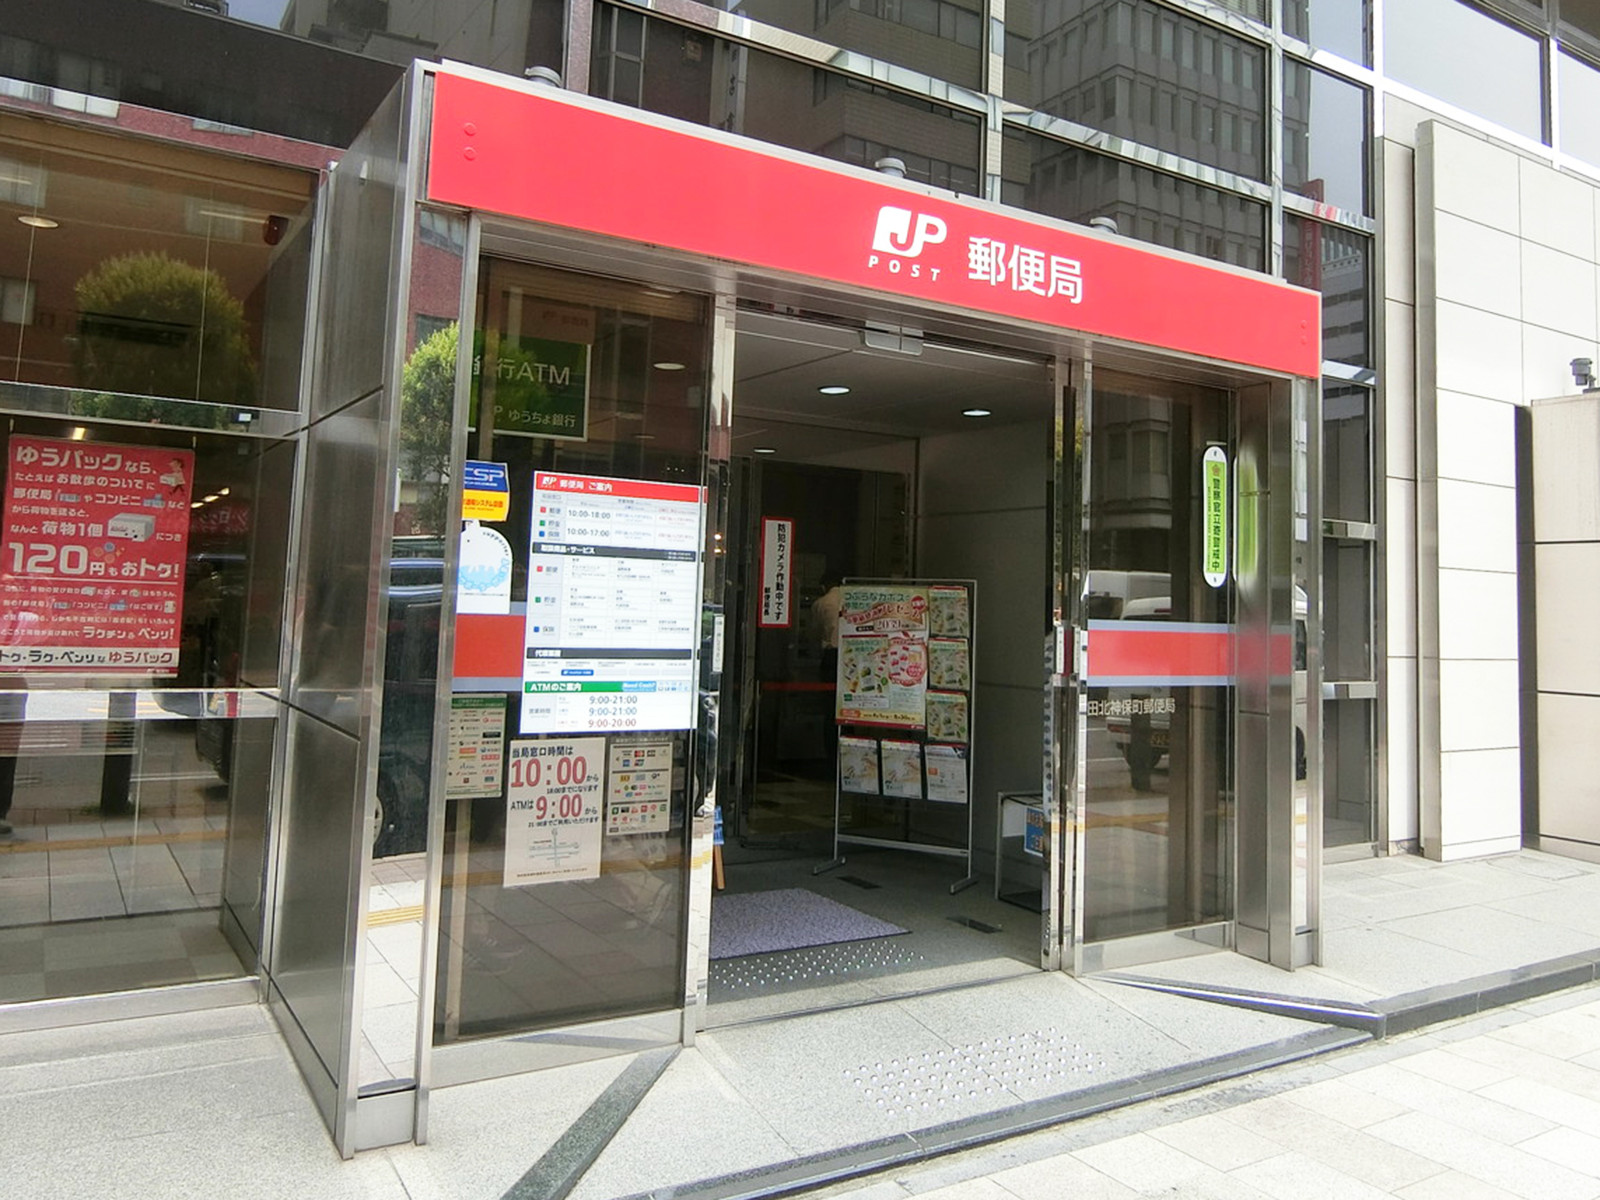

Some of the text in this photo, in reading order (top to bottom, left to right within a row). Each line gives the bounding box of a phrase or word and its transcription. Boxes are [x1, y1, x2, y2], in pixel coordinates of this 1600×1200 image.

[871, 205, 948, 258] JP
[868, 255, 941, 282] POST
[968, 237, 1083, 304] 郵便局
[509, 409, 576, 427] ゆうちょ銀行
[13, 487, 53, 500] 郵便局
[512, 746, 573, 758] 当局窓口時間は
